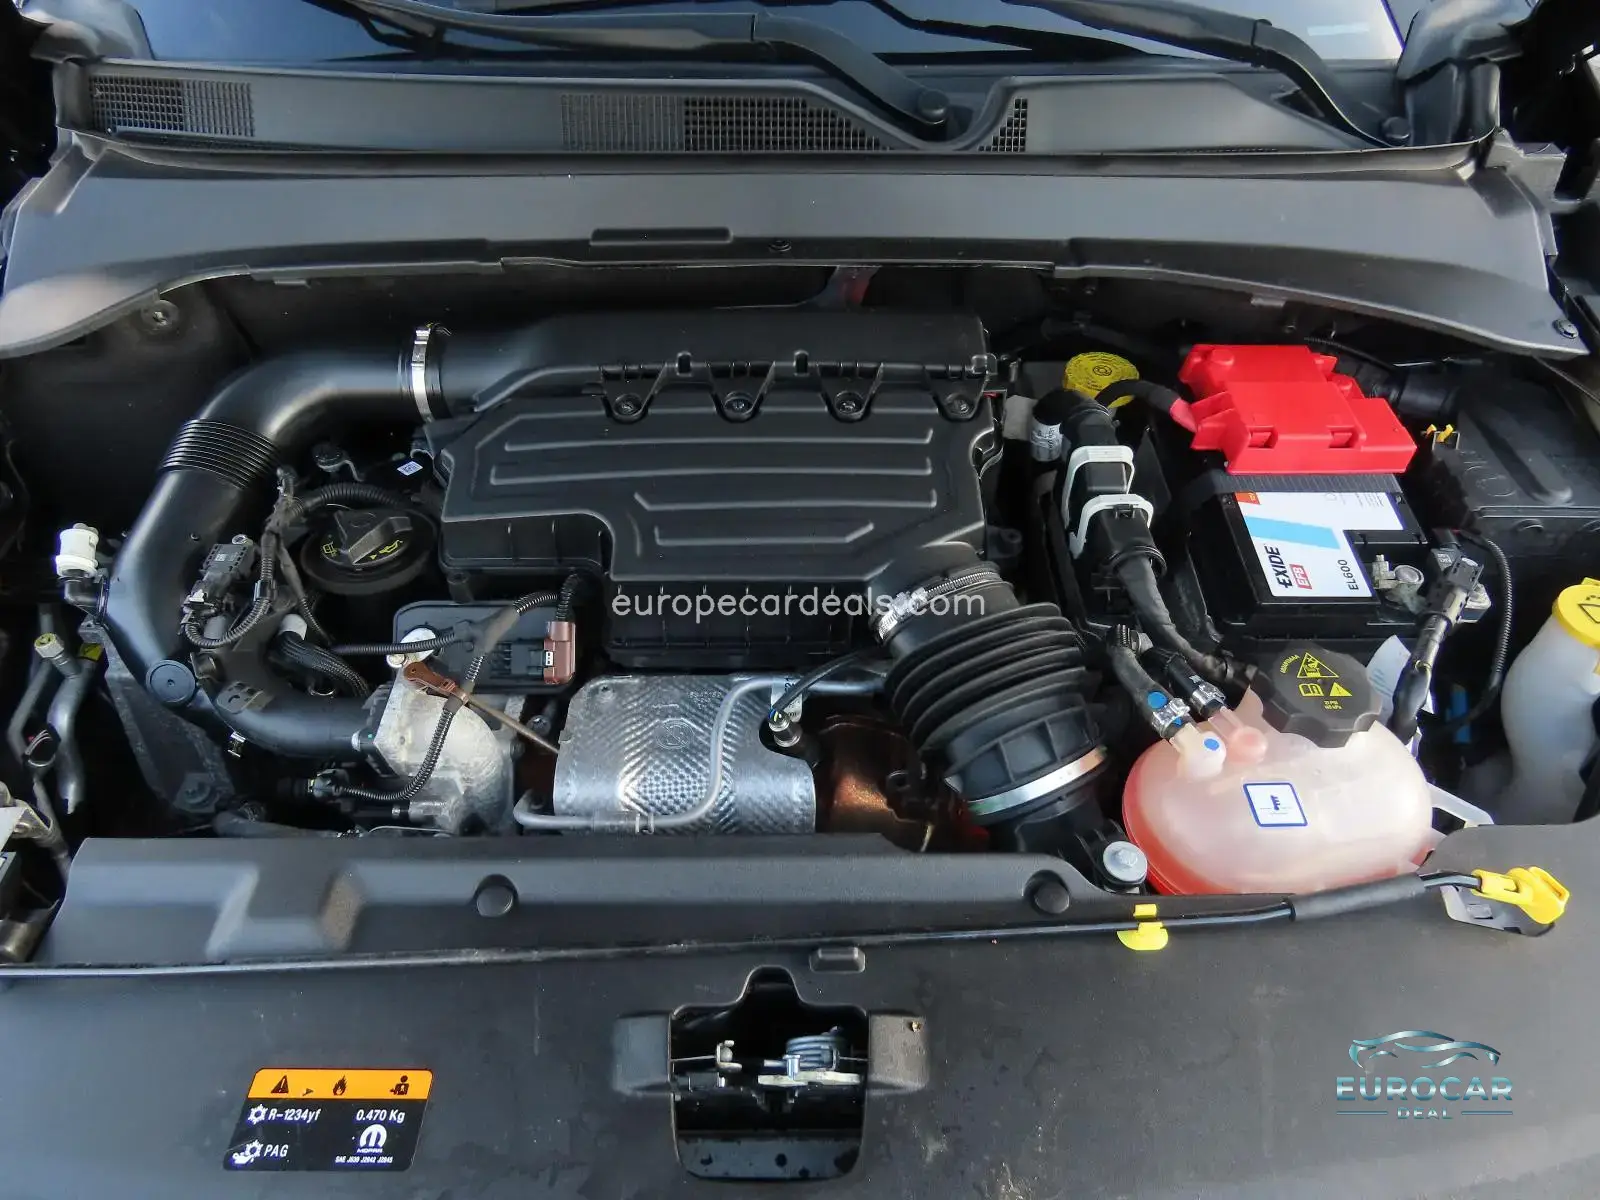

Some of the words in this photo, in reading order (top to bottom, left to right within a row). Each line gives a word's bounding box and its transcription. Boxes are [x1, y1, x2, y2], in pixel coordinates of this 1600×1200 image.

[1263, 545, 1294, 589] EXIDE
[1337, 559, 1360, 591] EL600
[268, 1108, 321, 1123] R-1234yf
[356, 1109, 388, 1121] 0.470
[388, 1109, 406, 1123] Kg
[264, 1144, 289, 1158] PAG
